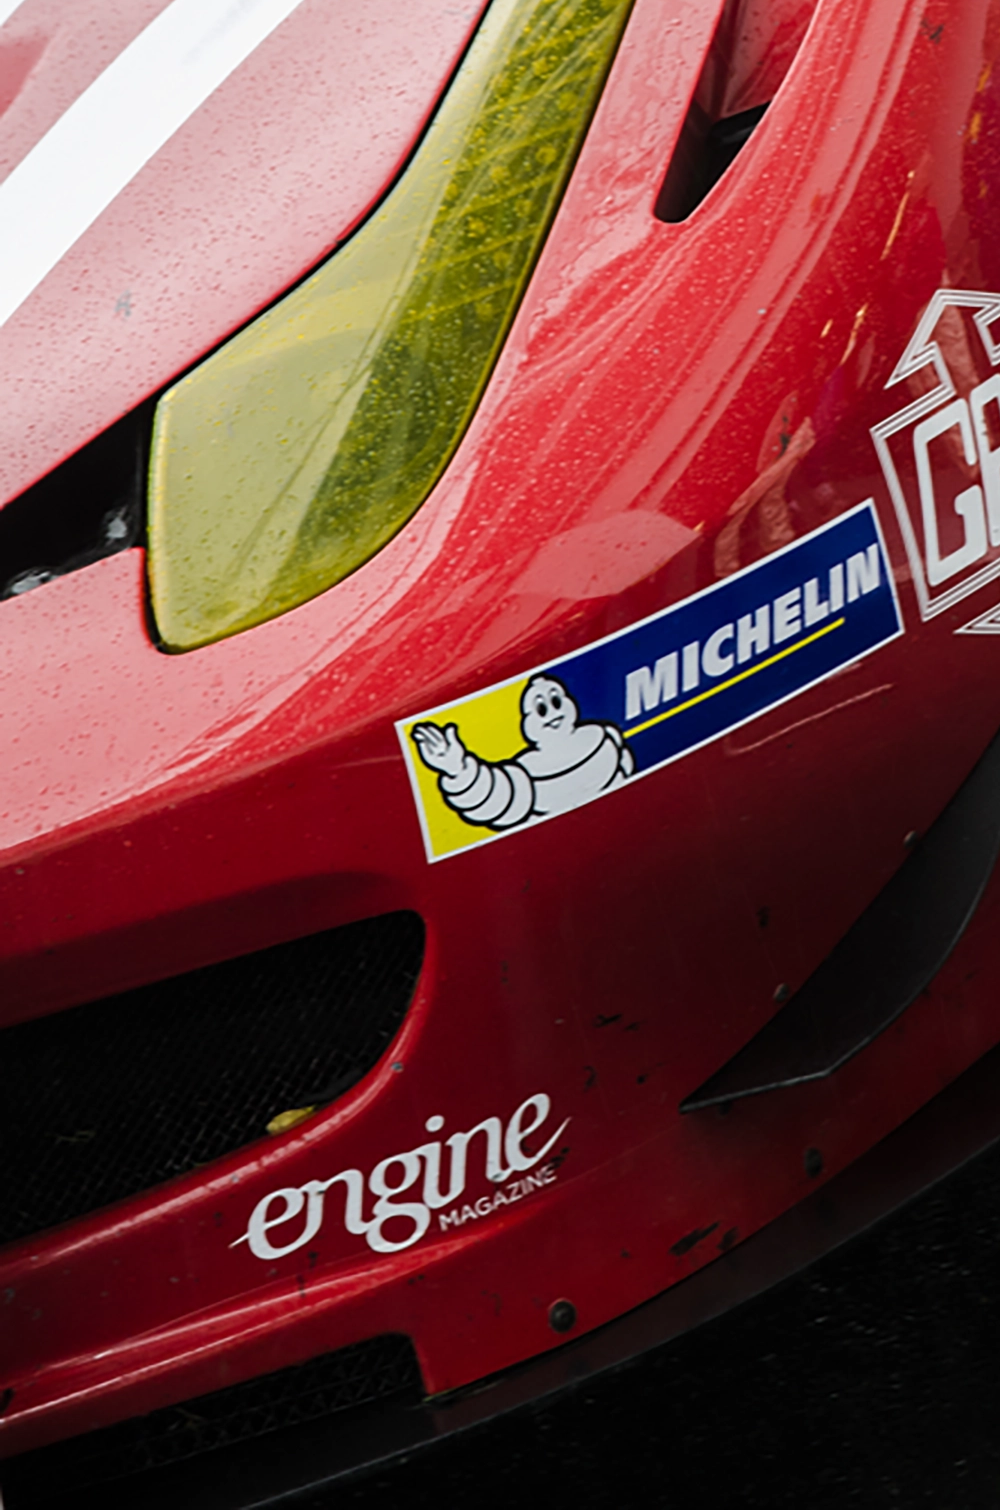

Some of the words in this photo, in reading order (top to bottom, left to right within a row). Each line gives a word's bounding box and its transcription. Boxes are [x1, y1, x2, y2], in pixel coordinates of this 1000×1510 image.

[624, 542, 881, 721] MICHELIN
[228, 1092, 573, 1260] engine
[438, 1162, 557, 1231] MAGAZINE
